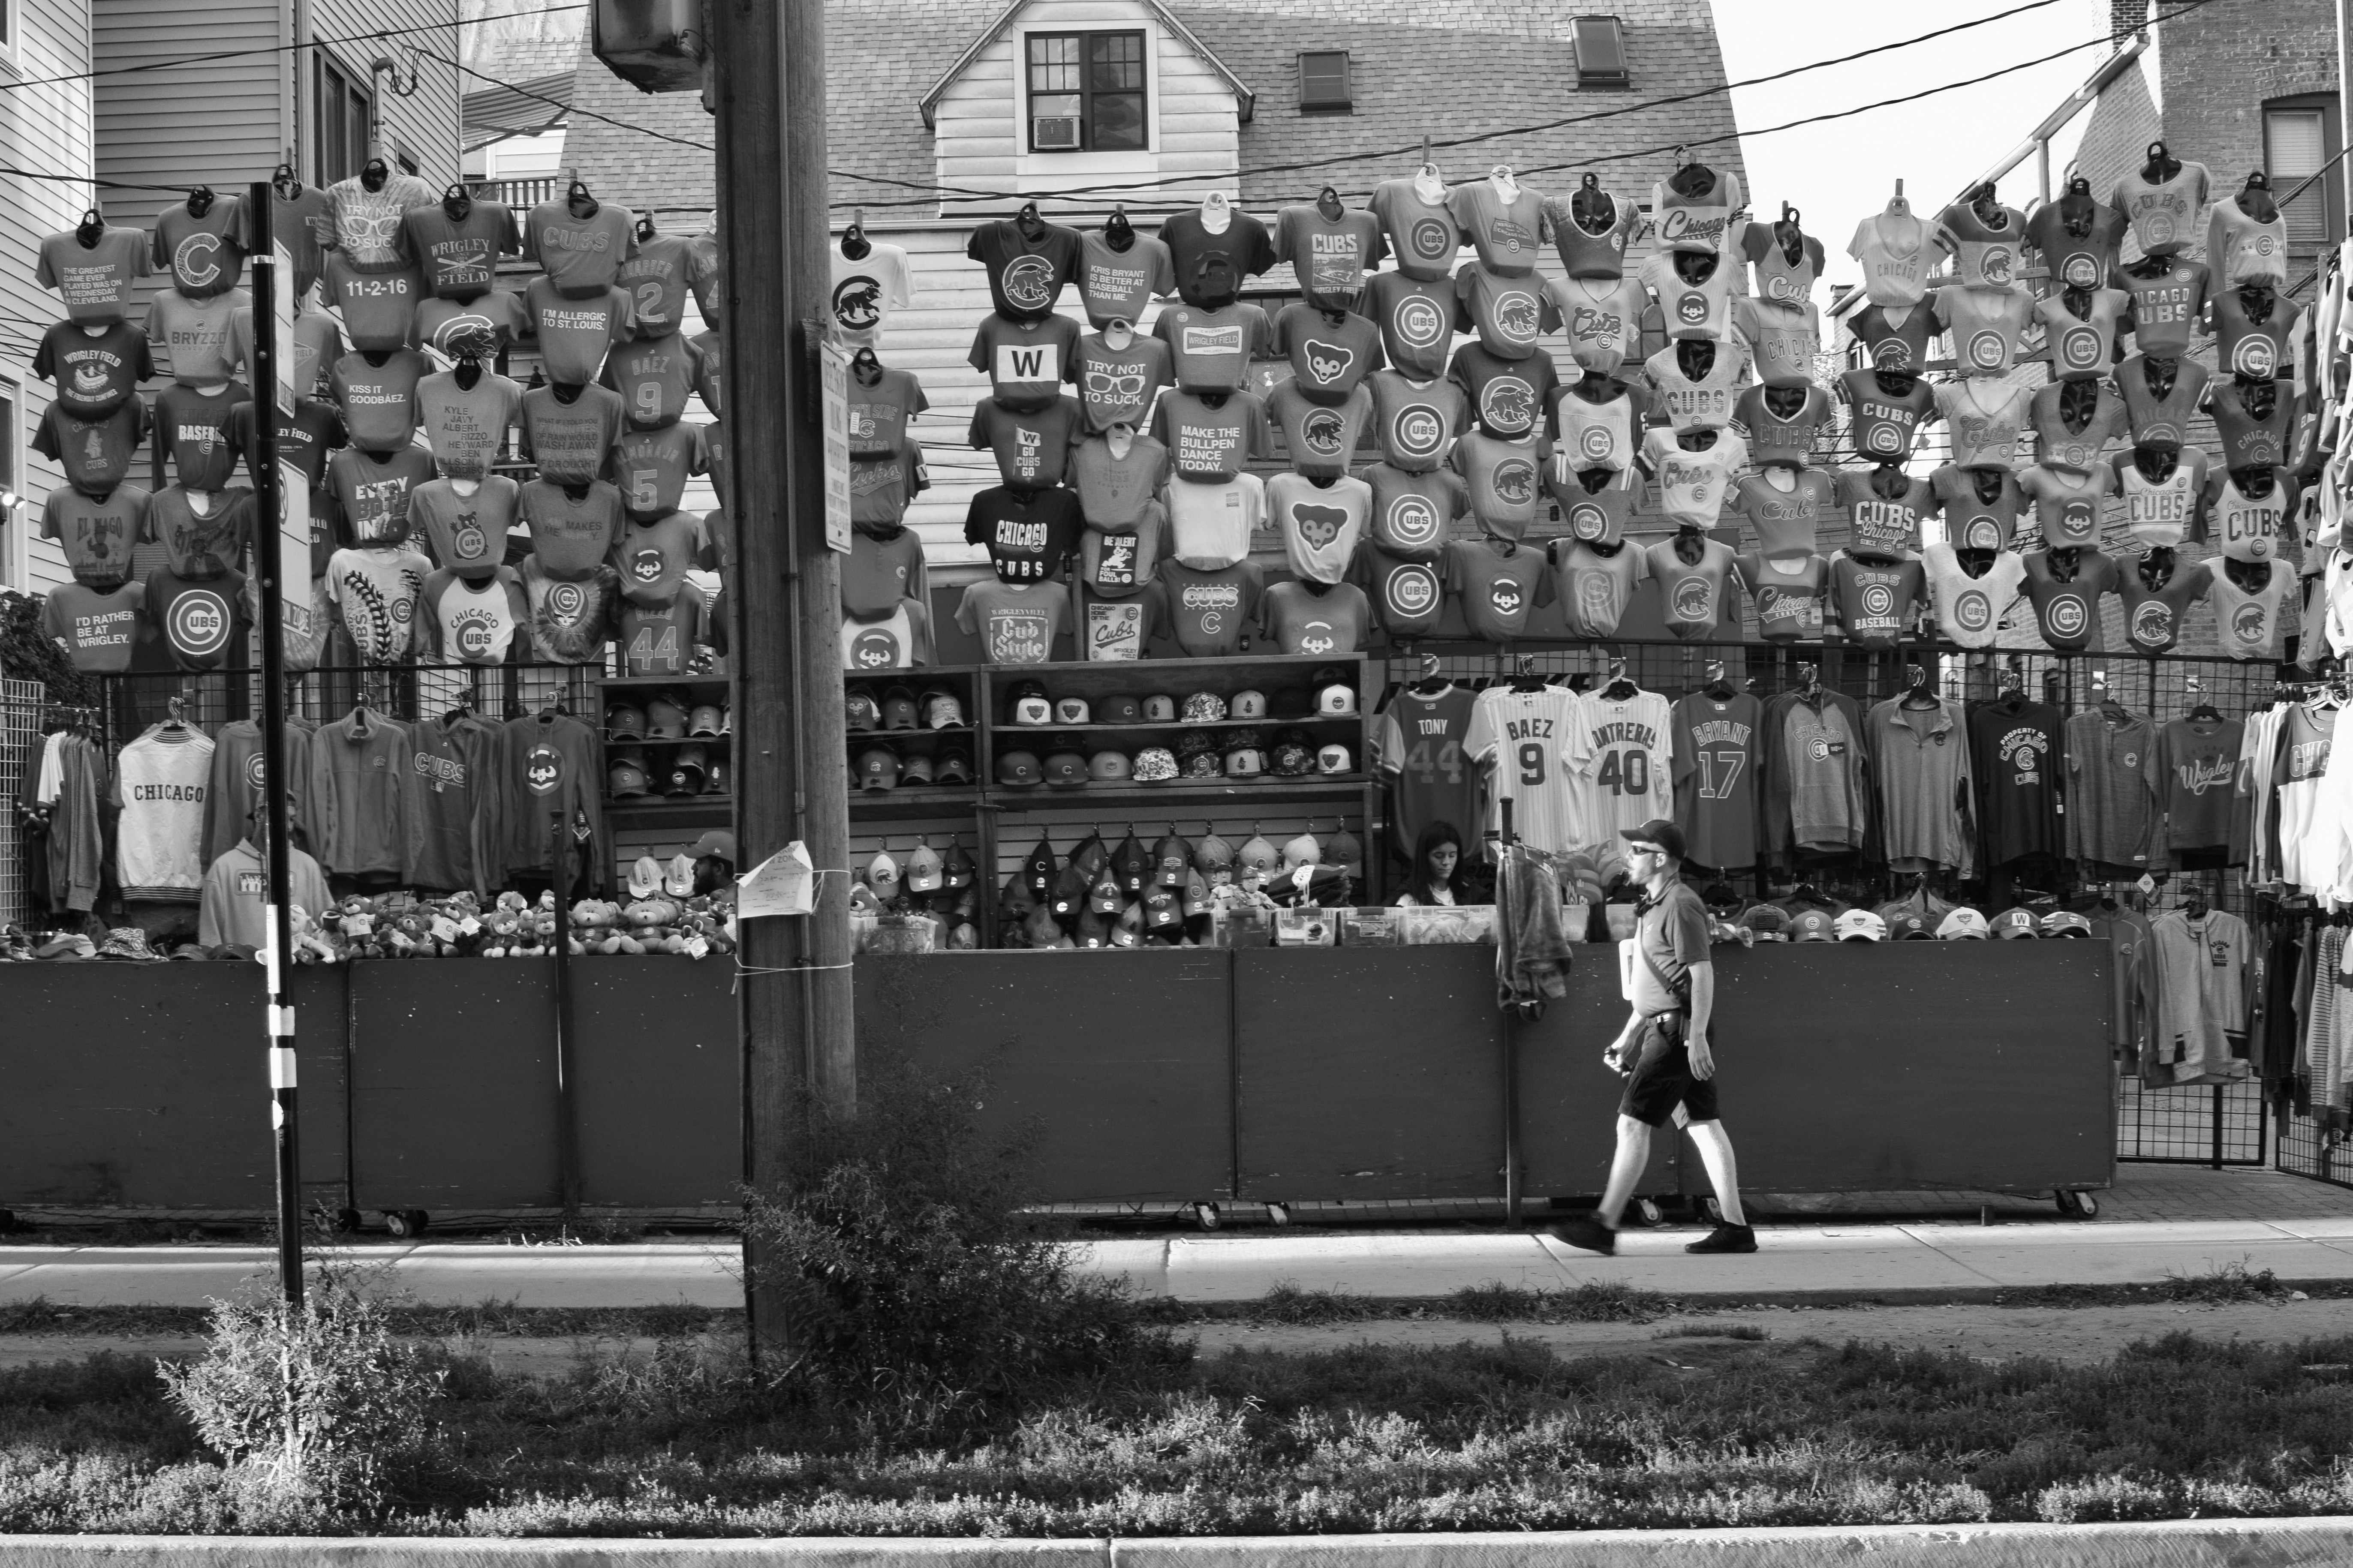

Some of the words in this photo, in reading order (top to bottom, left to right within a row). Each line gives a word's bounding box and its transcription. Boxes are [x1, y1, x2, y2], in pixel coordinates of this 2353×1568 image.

[345, 204, 372, 216] TRY
[375, 204, 403, 216] NOT
[2132, 194, 2187, 216] CUBS
[344, 237, 359, 248] TO
[543, 227, 611, 252] CUBS
[1312, 234, 1357, 253] CUBS
[431, 238, 490, 257] WRIGLEY
[175, 232, 221, 287] C
[78, 264, 116, 273] GREATEST
[1090, 265, 1110, 276] KRIS
[1111, 268, 1145, 279] BRYANT
[63, 274, 84, 282] GAME
[437, 271, 489, 285] FIELD
[1089, 273, 1098, 282] IS
[1099, 274, 1132, 285] BETTER
[1132, 278, 1144, 286] AT
[64, 282, 92, 290] PLAYED
[70, 288, 116, 297] WEDNESDAY
[346, 279, 408, 297] 11-2-16
[1089, 281, 1134, 294] BASEBALL
[72, 295, 120, 305] CLEVELAND.
[1088, 290, 1112, 300] THAN
[1113, 292, 1128, 300] ME.
[1878, 286, 1917, 303] CHICAGO
[543, 309, 556, 318] I'M
[558, 309, 606, 321] ALLERGIC
[543, 318, 555, 327] TO
[557, 319, 572, 329] ST.
[574, 320, 605, 330] LOUIS.
[1188, 336, 1217, 345] WRIGLEY
[63, 350, 99, 366] WRIGLEY
[99, 351, 122, 367] FIELD
[296, 349, 313, 357] FIELD
[632, 356, 670, 375] BAEZ
[1011, 349, 1043, 377] W
[1086, 360, 1114, 374] TRY
[1117, 363, 1146, 375] NOT
[349, 385, 371, 394] KISS
[373, 385, 382, 394] IT
[635, 382, 662, 423] 9
[1083, 391, 1101, 403] TO
[1104, 392, 1144, 406] SUCK.
[1667, 389, 1725, 415] CUBS
[444, 406, 468, 415] KYLE
[1862, 403, 1914, 426] CUBS
[442, 423, 479, 431] ALBERT
[1181, 426, 1215, 439] MAKE
[1218, 427, 1240, 438] THE
[291, 428, 313, 442] FIELD
[548, 433, 566, 441] RAIN
[567, 433, 598, 441] WOULD
[1023, 433, 1036, 443] W
[1180, 437, 1235, 448] BULLPEN
[1758, 424, 1813, 448] CUBS
[2238, 430, 2279, 450] CHICAGO
[448, 441, 493, 449] HEYWARD
[537, 442, 567, 450] WASH
[569, 441, 597, 450] AWAY
[1022, 447, 1035, 456] GO
[461, 449, 480, 457] BEN
[1180, 448, 1222, 460] DANCE
[2251, 445, 2270, 463] C
[87, 459, 108, 470] CUBS
[548, 460, 596, 468] DROUGHT
[1017, 457, 1041, 466] CUBS
[1179, 460, 1223, 472] TODAY.
[1022, 467, 1035, 476] GO
[632, 469, 658, 511] 5
[2130, 494, 2184, 521] CUBS
[1855, 501, 1915, 532] CUBS
[566, 521, 602, 531] MAKES
[2228, 508, 2280, 541] CUBS
[996, 520, 1047, 546] CHICAGO
[1862, 521, 1907, 545] Chicago
[1029, 539, 1044, 553] C
[1104, 536, 1113, 546] BE
[1116, 536, 1136, 547] ALERT
[996, 559, 1043, 577] CUBS
[1854, 573, 1901, 586] CUBS
[1182, 586, 1239, 608] CUBS
[75, 618, 90, 626] I'D
[93, 611, 134, 624] RATHER
[451, 608, 499, 629] CHICAGO
[1201, 612, 1222, 634] C
[1855, 617, 1900, 630] BASEBALL
[77, 628, 92, 638] BE
[94, 626, 108, 635] AT
[456, 619, 492, 658] CUBS
[1095, 620, 1135, 643] Cubs
[77, 634, 130, 648] WRIGLEY.
[629, 626, 679, 670] 44
[1418, 719, 1447, 735] TONY
[1507, 718, 1554, 741] BAEZ
[1691, 721, 1752, 747] BRYANT
[1793, 724, 1843, 742] CHICAGO
[2000, 728, 2036, 745] PROPERTY
[2000, 735, 2048, 760] CHICAGO
[414, 752, 467, 784] CUBS
[1406, 741, 1462, 784] 44
[1520, 743, 1544, 785] 9
[1598, 750, 1648, 796] 40
[1698, 751, 1746, 799] 17
[2180, 754, 2236, 796] Wrigley
[134, 784, 204, 802] CHICAGO
[2016, 914, 2027, 924] W
